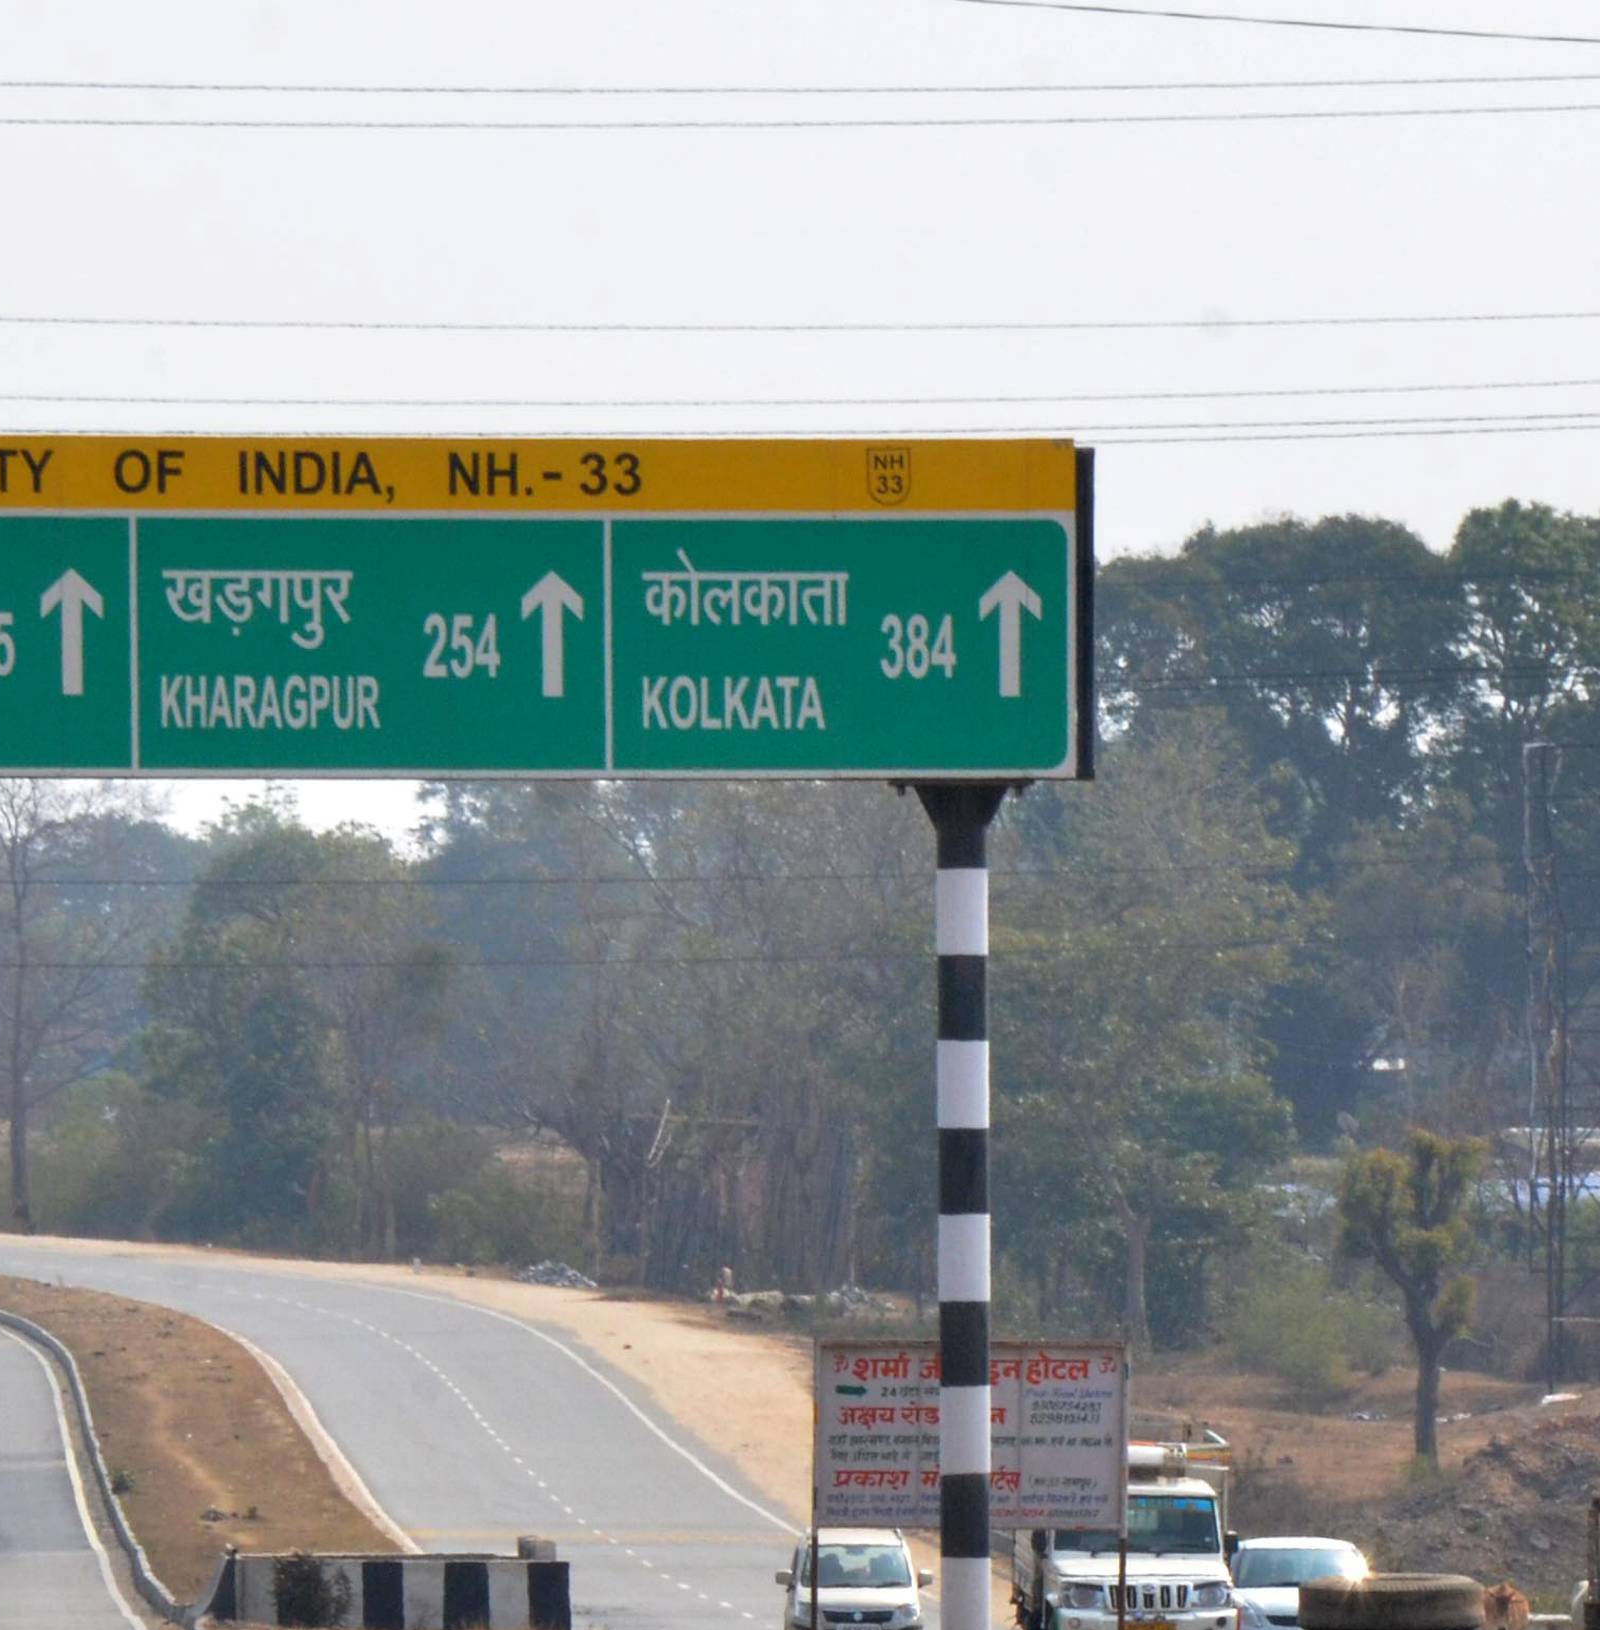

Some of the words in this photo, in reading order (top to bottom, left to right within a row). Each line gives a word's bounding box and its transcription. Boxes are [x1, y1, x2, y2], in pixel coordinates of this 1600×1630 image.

[112, 447, 186, 495] OF
[237, 449, 396, 504] INDIA,
[873, 454, 904, 470] NH
[877, 475, 904, 494] 33
[162, 569, 354, 650] खड़गपुर
[641, 548, 850, 626] कोलकाता
[423, 612, 502, 679] 254
[880, 613, 957, 680] 384
[160, 674, 381, 730] KHARAGPUR
[642, 675, 826, 730] KOLKATA
[851, 1350, 913, 1382] शर्मा
[1025, 1349, 1091, 1386] होटल
[838, 1406, 897, 1430] अक्षय
[831, 1469, 912, 1491] प्रकाश
